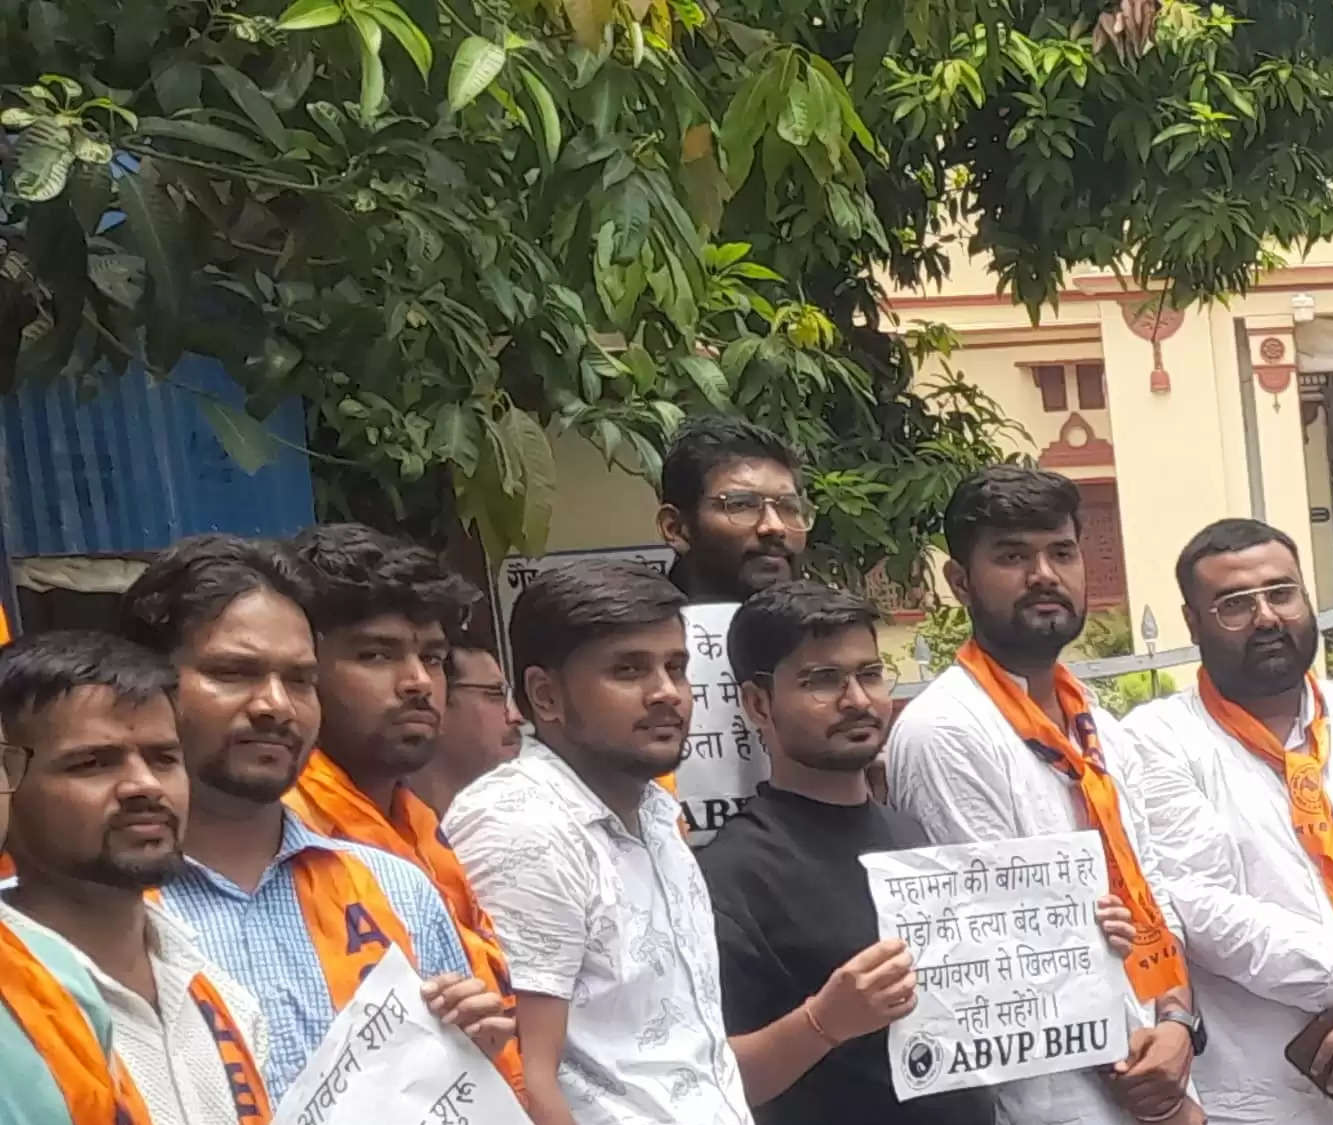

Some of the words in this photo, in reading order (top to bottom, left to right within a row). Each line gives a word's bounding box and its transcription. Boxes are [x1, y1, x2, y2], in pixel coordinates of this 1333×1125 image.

[885, 872, 957, 905] महामना
[963, 859, 989, 894] की
[995, 856, 1050, 890] बगिया
[1056, 850, 1070, 884] में
[1075, 849, 1097, 886] हरे
[936, 907, 962, 942] की
[967, 912, 1006, 943] हत्या
[1012, 902, 1041, 936] बंद
[915, 954, 990, 992] पर्यावरण
[995, 947, 1013, 981] से
[1017, 944, 1091, 978] खिलवाड़
[357, 988, 409, 1050] शीघ्र
[949, 1031, 1035, 1074] ABVP
[1043, 1019, 1109, 1059] BHU
